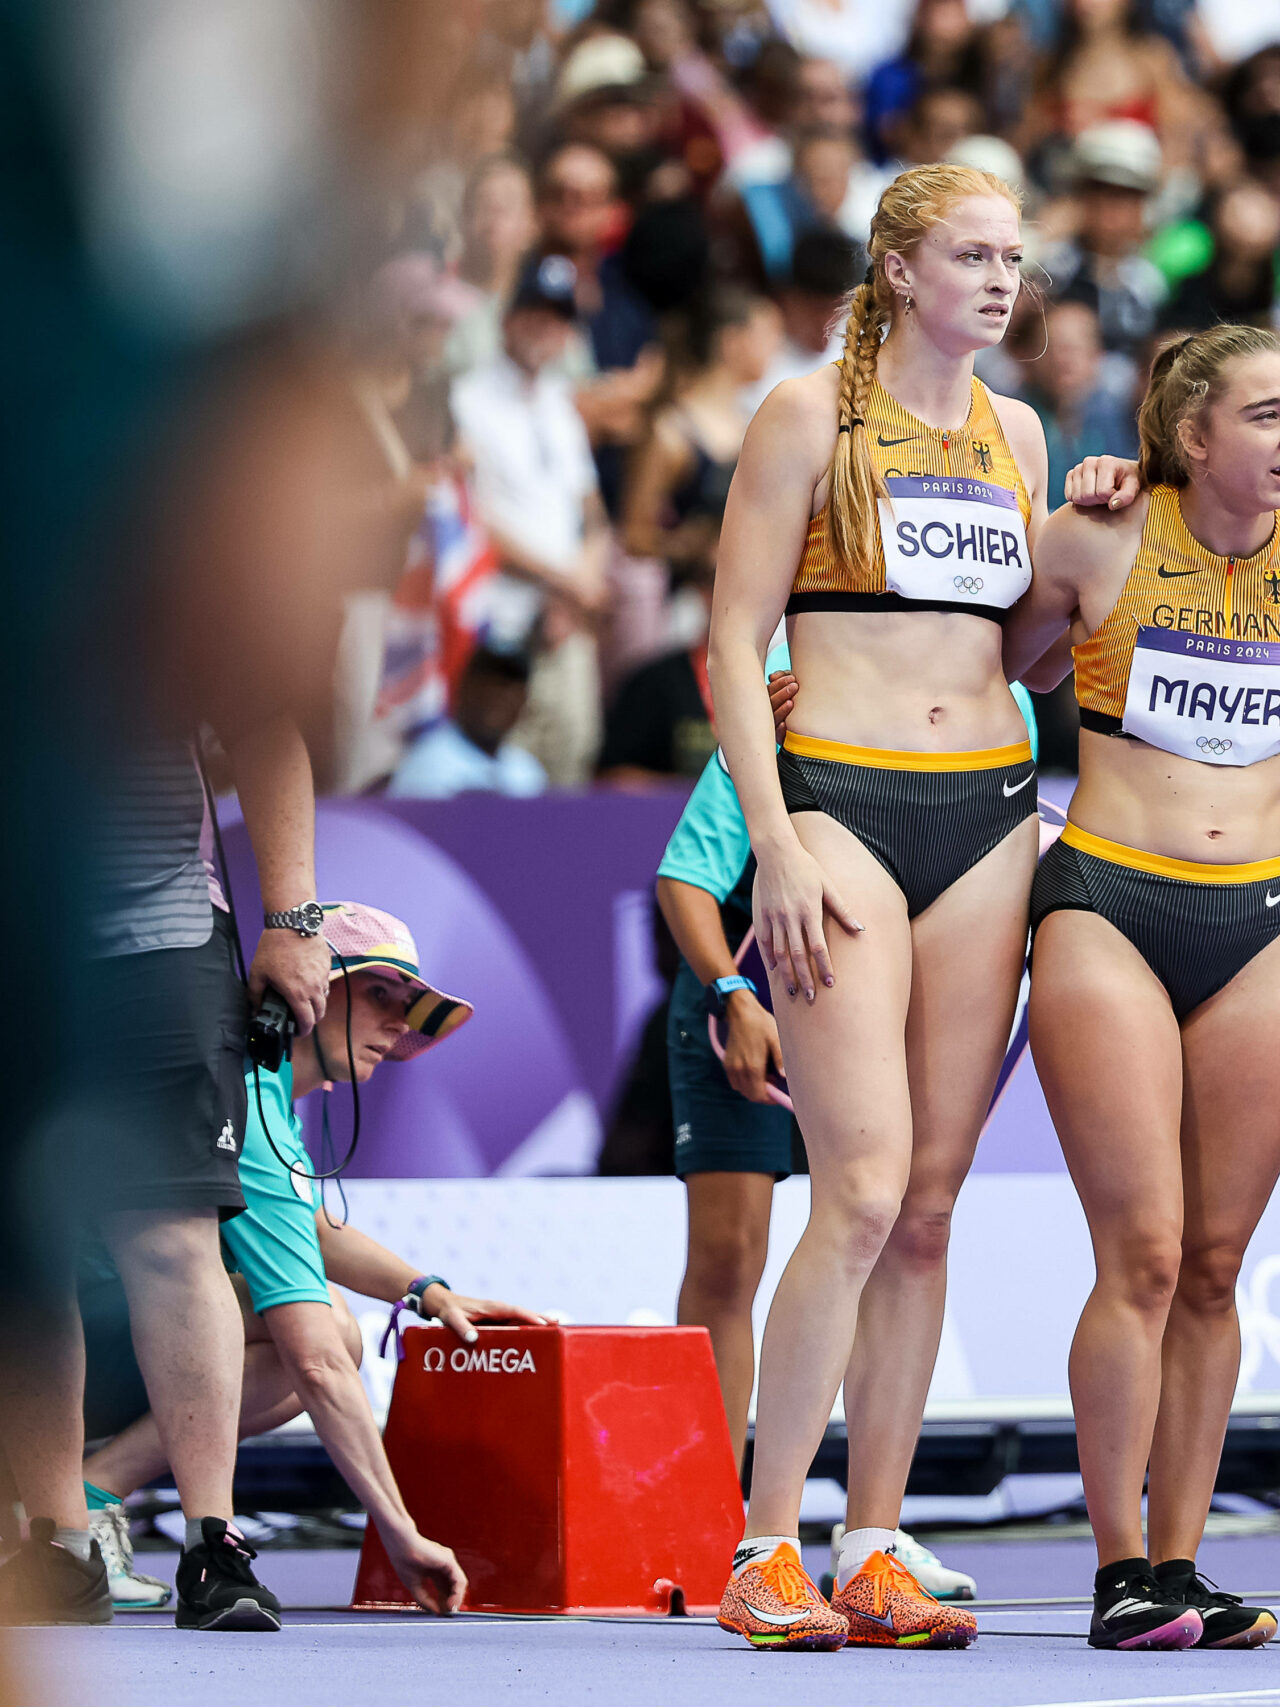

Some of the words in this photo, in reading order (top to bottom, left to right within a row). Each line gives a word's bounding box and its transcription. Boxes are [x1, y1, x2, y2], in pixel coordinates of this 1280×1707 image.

[922, 482, 964, 494] PARIS
[967, 484, 993, 499] 2024
[896, 521, 1023, 568] SCHIER
[1185, 638, 1231, 655] PARIS
[1235, 646, 1270, 659] 2024
[450, 1347, 537, 1373] OMEGA
